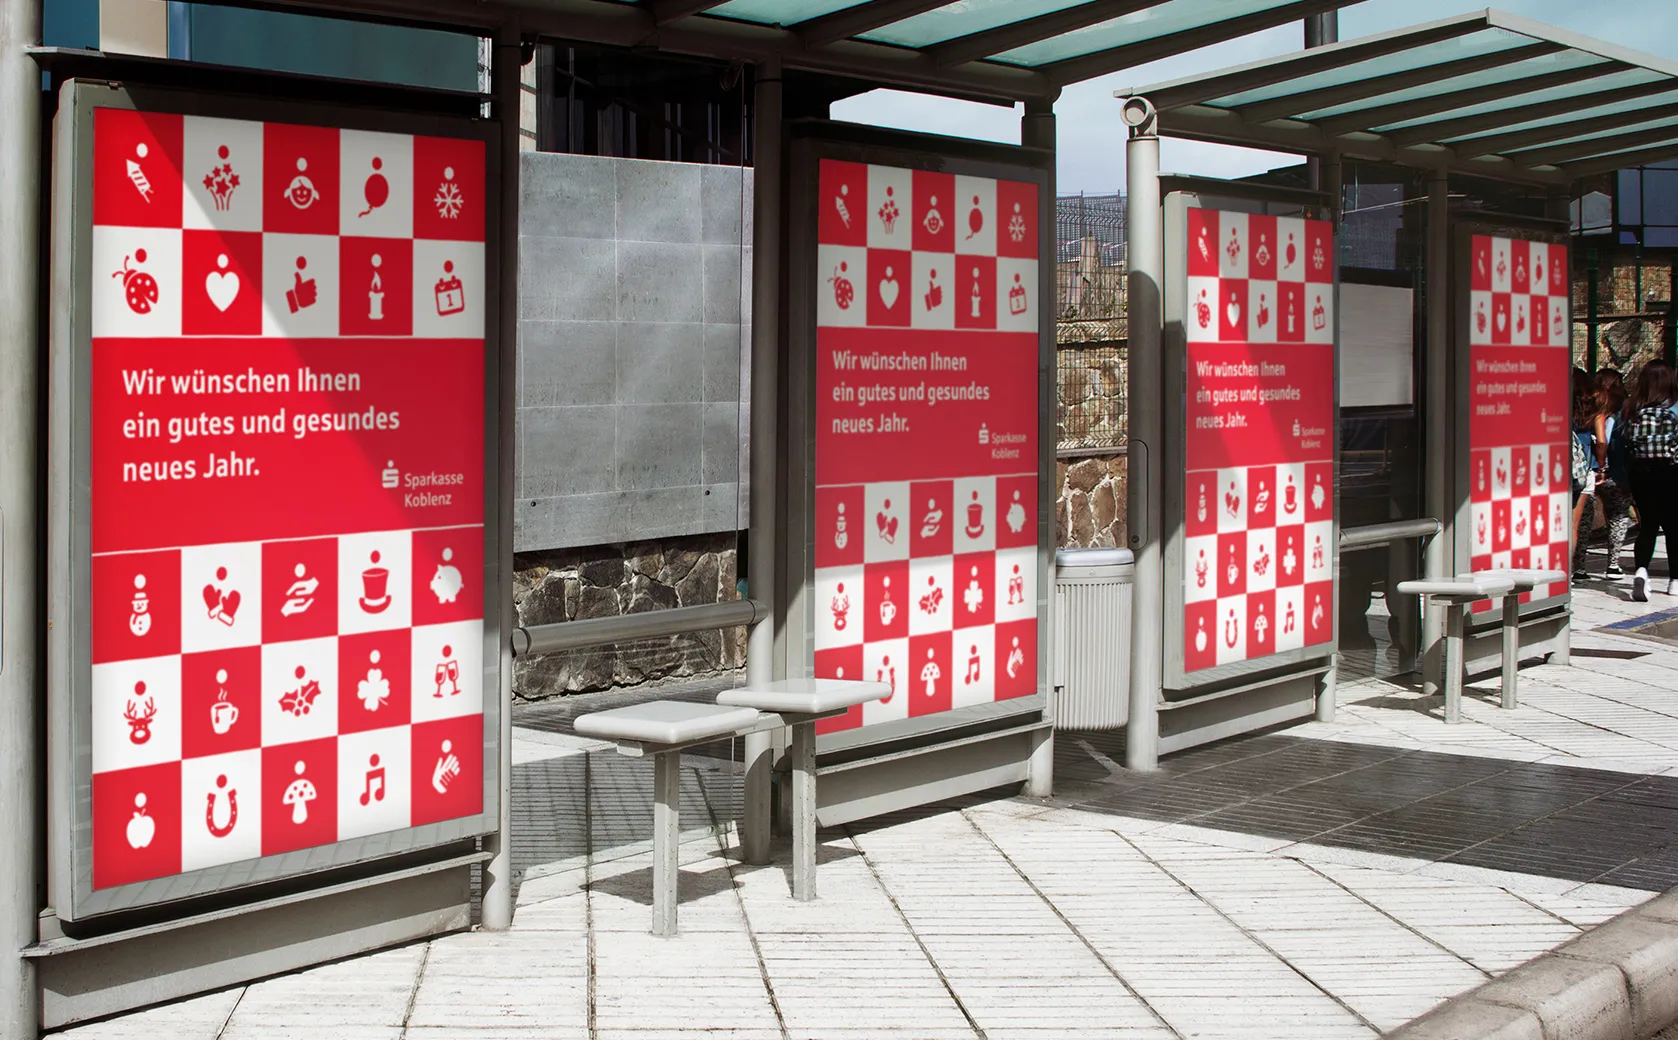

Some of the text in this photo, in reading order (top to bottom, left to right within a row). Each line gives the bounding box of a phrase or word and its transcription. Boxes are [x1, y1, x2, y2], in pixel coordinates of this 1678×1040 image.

[447, 293, 454, 307] 1
[832, 350, 967, 371] Wir wünschen Ihnen
[1196, 360, 1286, 377] Wir wünschen Ihnen
[123, 367, 361, 395] Wir wünschen Ihnen
[832, 381, 990, 406] ein gutes und gesundes
[1196, 384, 1300, 406] ein gutes und gesundes
[123, 405, 400, 443] ein gutes und gesundes
[832, 412, 910, 434] neues Jahr.
[1196, 411, 1248, 428] neues Jahr.
[991, 432, 1027, 446] Sparkasse
[991, 448, 1020, 459] Koblenz
[123, 451, 260, 482] neues Jahr.
[404, 471, 464, 488] Sparkasse
[404, 492, 453, 507] Koblenz
